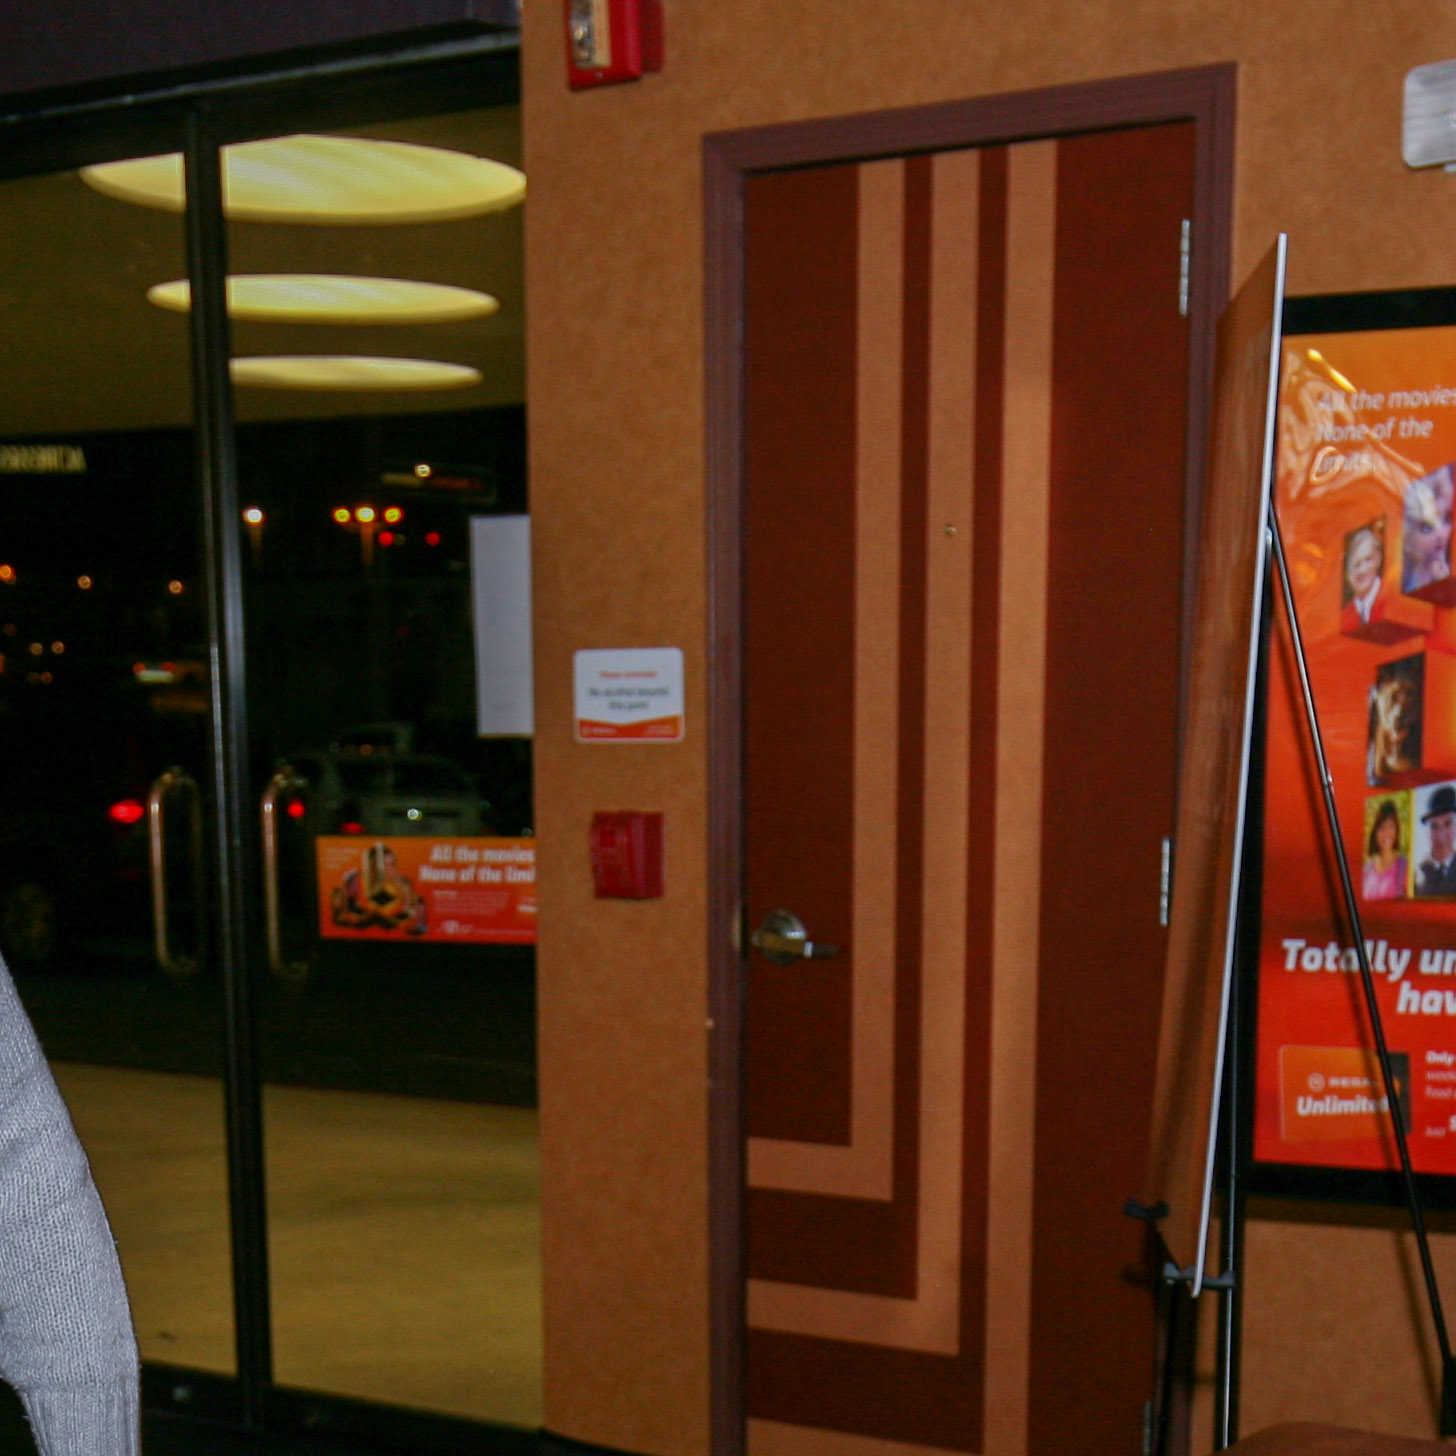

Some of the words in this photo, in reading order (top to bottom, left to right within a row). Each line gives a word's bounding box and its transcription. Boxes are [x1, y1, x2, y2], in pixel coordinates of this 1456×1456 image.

[1351, 388, 1385, 411] the
[1373, 416, 1395, 439] of
[1399, 415, 1433, 438] the
[1282, 938, 1412, 982] Totally
